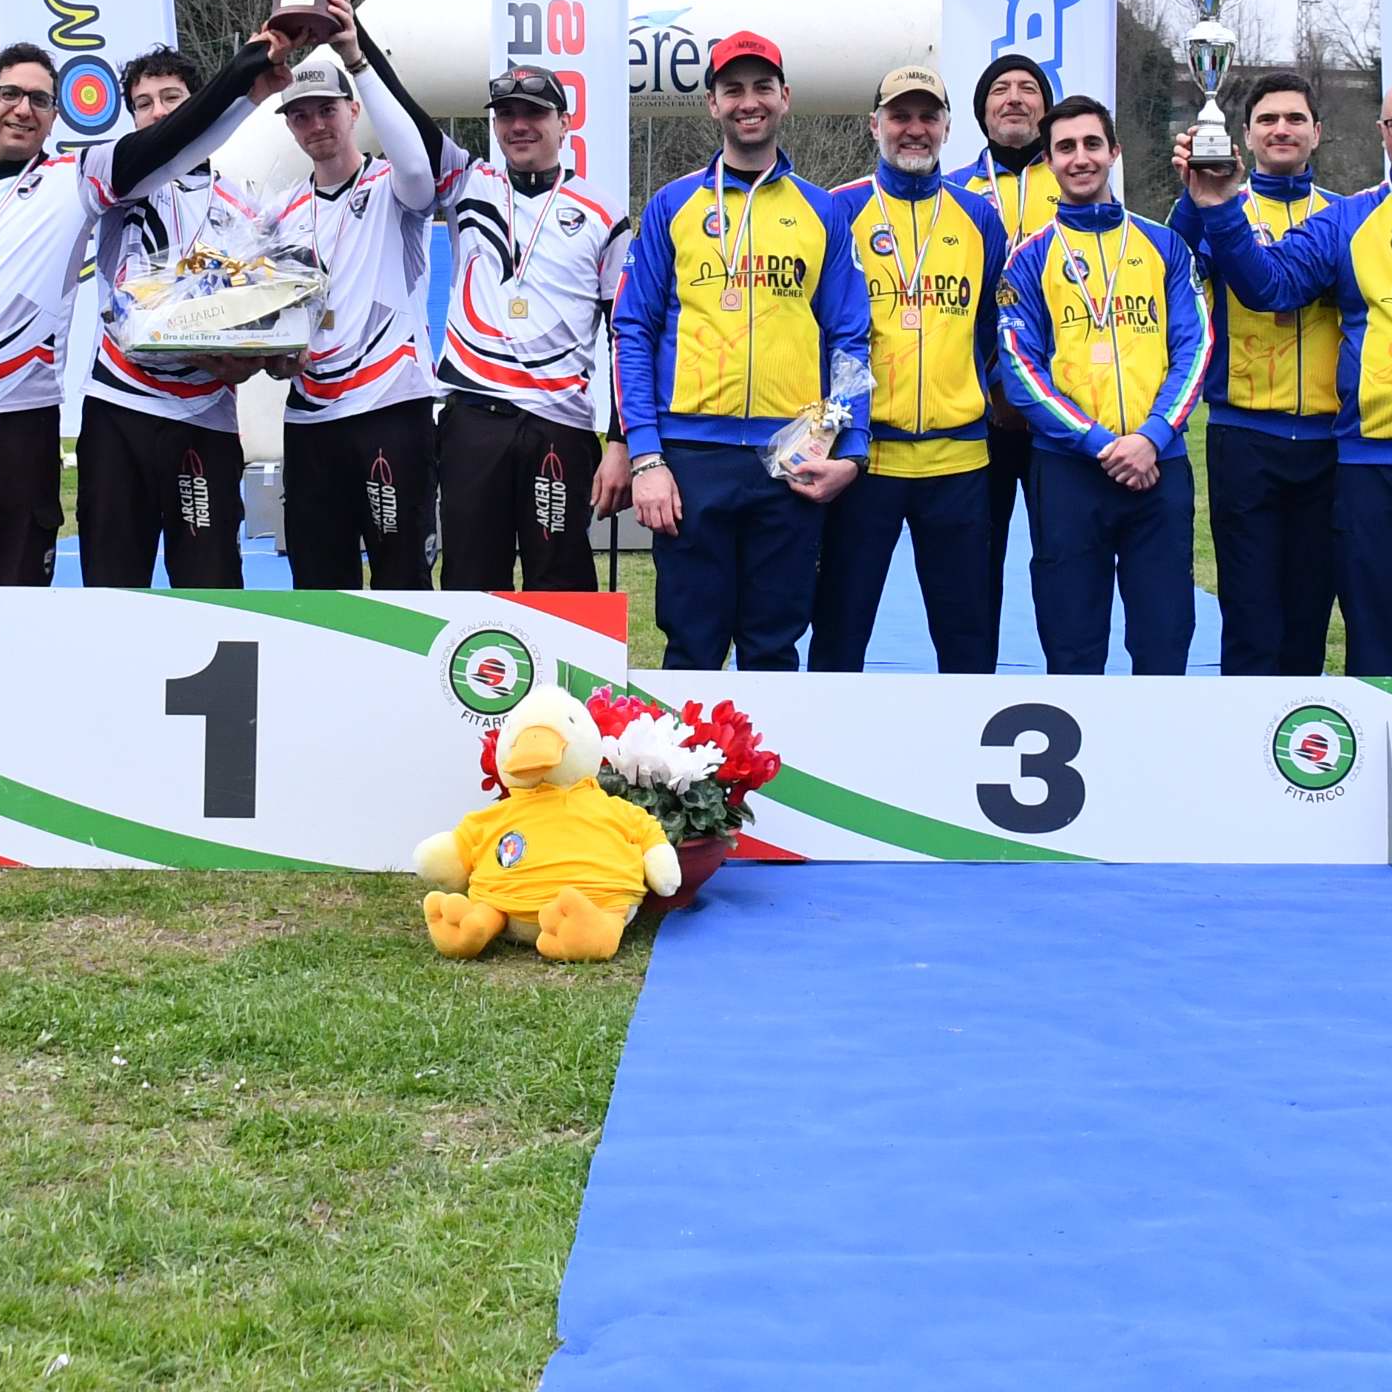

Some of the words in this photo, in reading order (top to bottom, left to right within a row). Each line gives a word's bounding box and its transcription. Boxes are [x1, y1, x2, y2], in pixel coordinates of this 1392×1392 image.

[178, 474, 196, 524] ARCIERI
[193, 476, 211, 528] TIGULLIO
[381, 485, 398, 535] TIGULLIO
[534, 476, 550, 528] ARCIERI
[550, 481, 567, 533] TIGULLIO
[165, 641, 260, 819] 1
[976, 702, 1086, 834] 3
[1285, 786, 1344, 803] FITARCO
